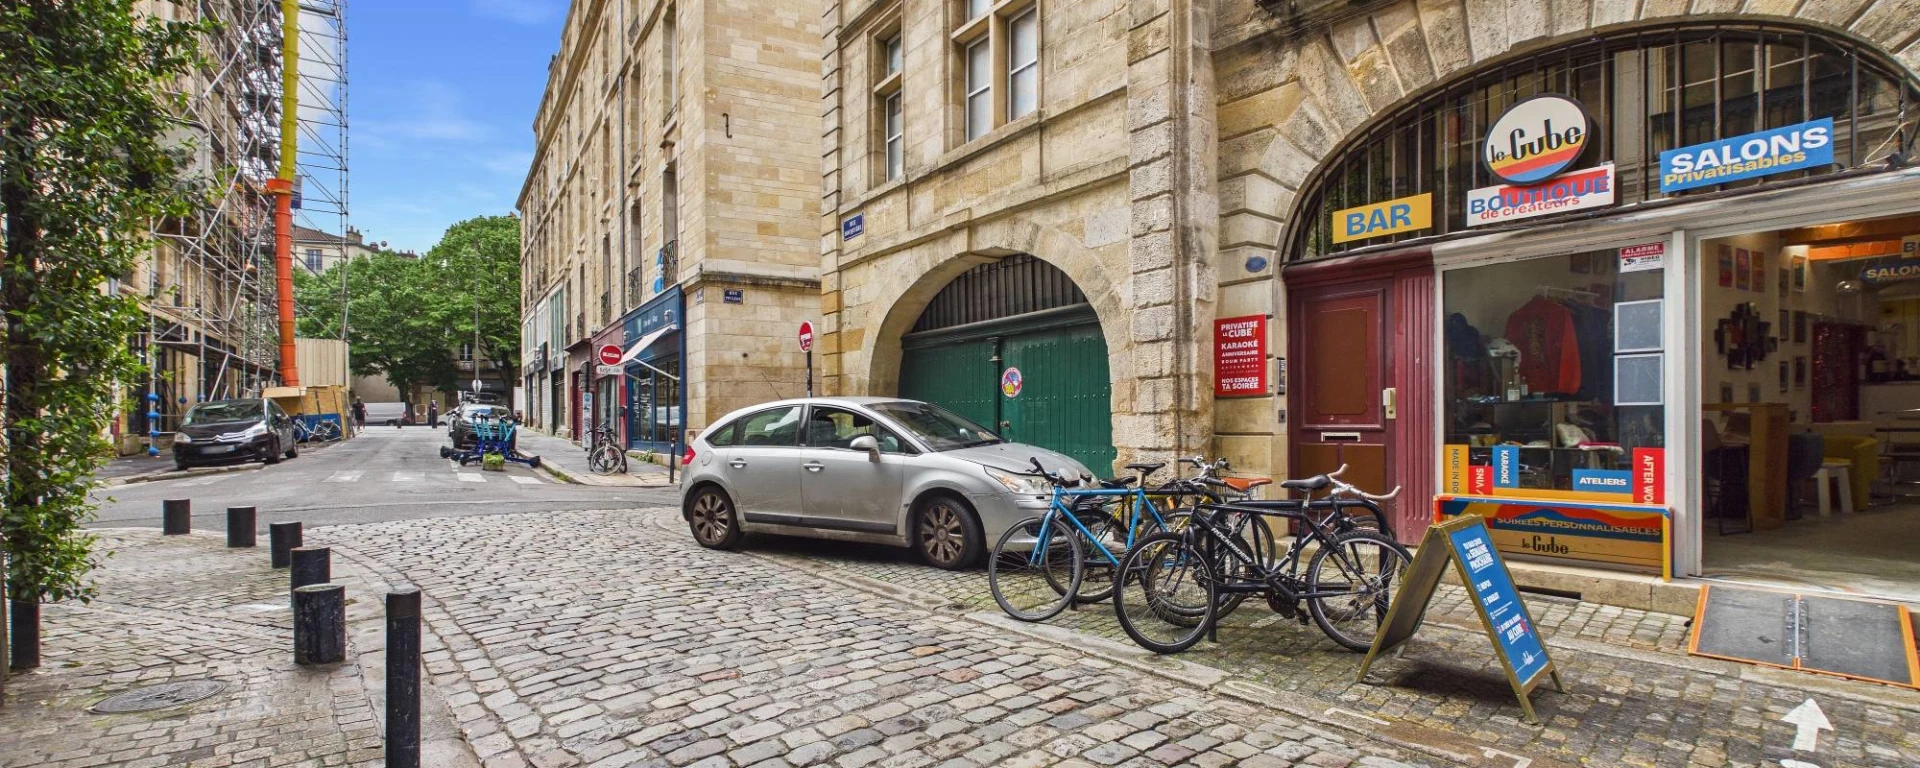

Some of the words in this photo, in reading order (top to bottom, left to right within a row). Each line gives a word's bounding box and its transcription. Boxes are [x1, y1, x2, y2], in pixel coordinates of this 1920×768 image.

[1490, 144, 1505, 164] le
[1509, 118, 1583, 161] Cube
[1671, 126, 1829, 175] SALONS
[1664, 149, 1807, 187] Privatisables
[1470, 175, 1610, 215] BOUTIQUE
[1346, 203, 1412, 236] BAR
[1480, 207, 1499, 220] de
[1625, 244, 1660, 255] ALARME
[1221, 320, 1258, 331] PRIVATISE
[1221, 339, 1259, 350] KARAOKÉ
[1452, 471, 1460, 480] IN
[1500, 449, 1510, 484] KARAOKÉ
[1643, 455, 1654, 484] AFTER
[1475, 467, 1485, 488] VINS
[1579, 477, 1627, 486] ATELIERS
[1643, 485, 1654, 505] WO
[1543, 519, 1660, 536] PERSONNALISABLES
[1211, 527, 1253, 563] ROCKRIDER
[1532, 535, 1569, 555] Cube
